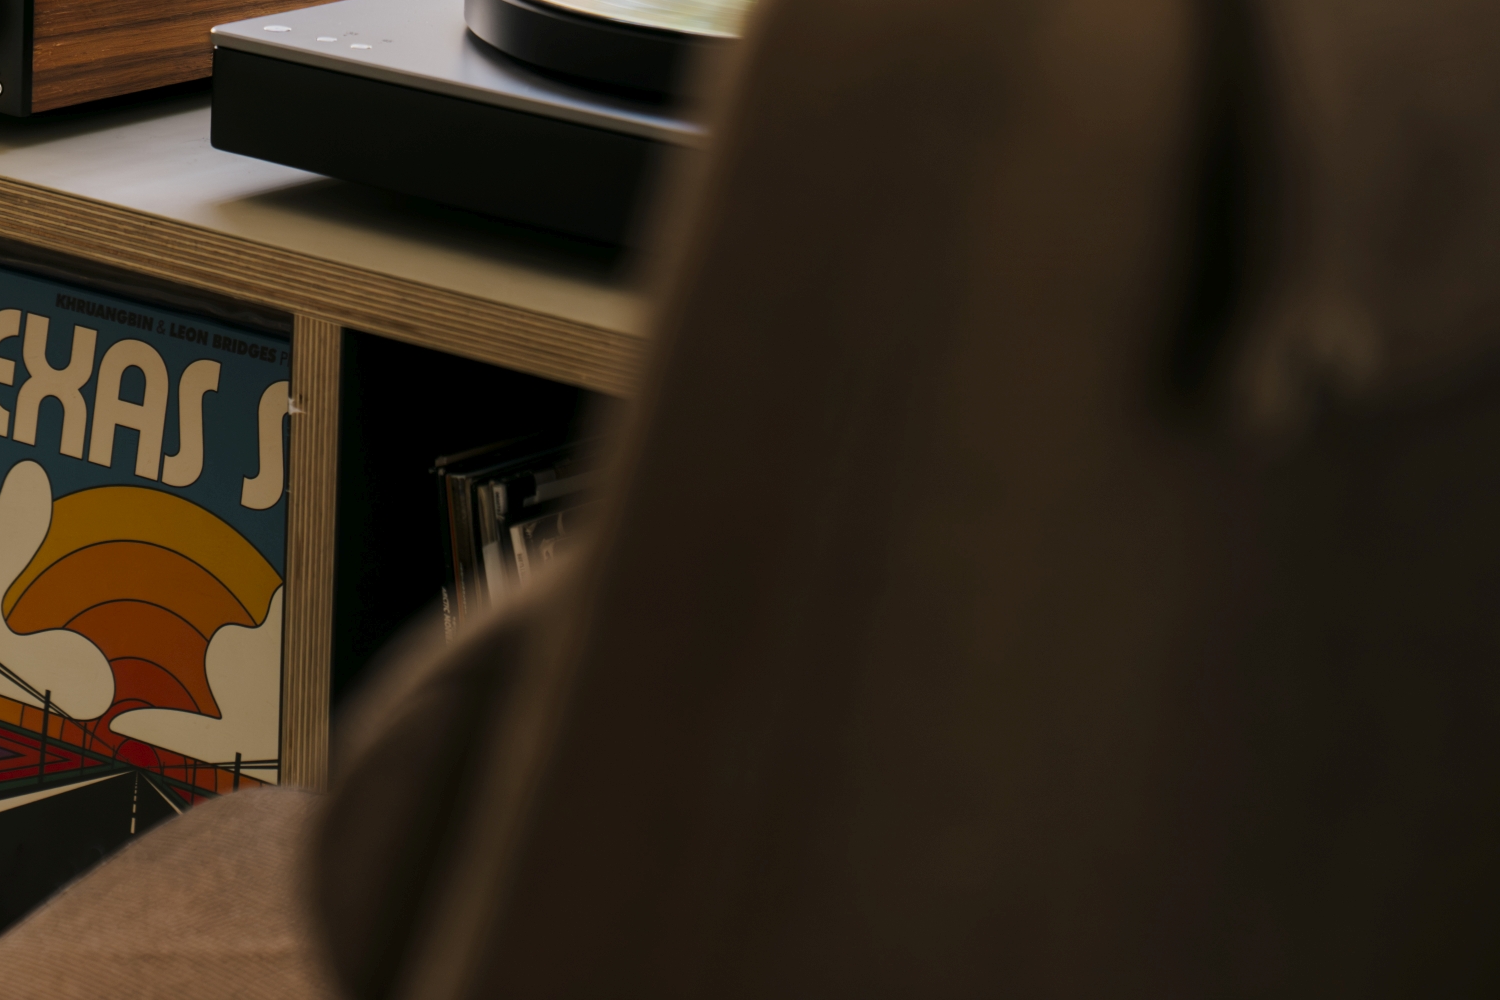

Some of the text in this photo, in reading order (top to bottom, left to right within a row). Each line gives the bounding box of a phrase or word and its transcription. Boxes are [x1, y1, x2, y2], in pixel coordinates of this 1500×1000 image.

[55, 293, 154, 331] KHRUANGBIN
[156, 319, 167, 335] &
[169, 322, 208, 347] LEON
[212, 334, 277, 364] BRIDGES
[240, 379, 290, 511] S
